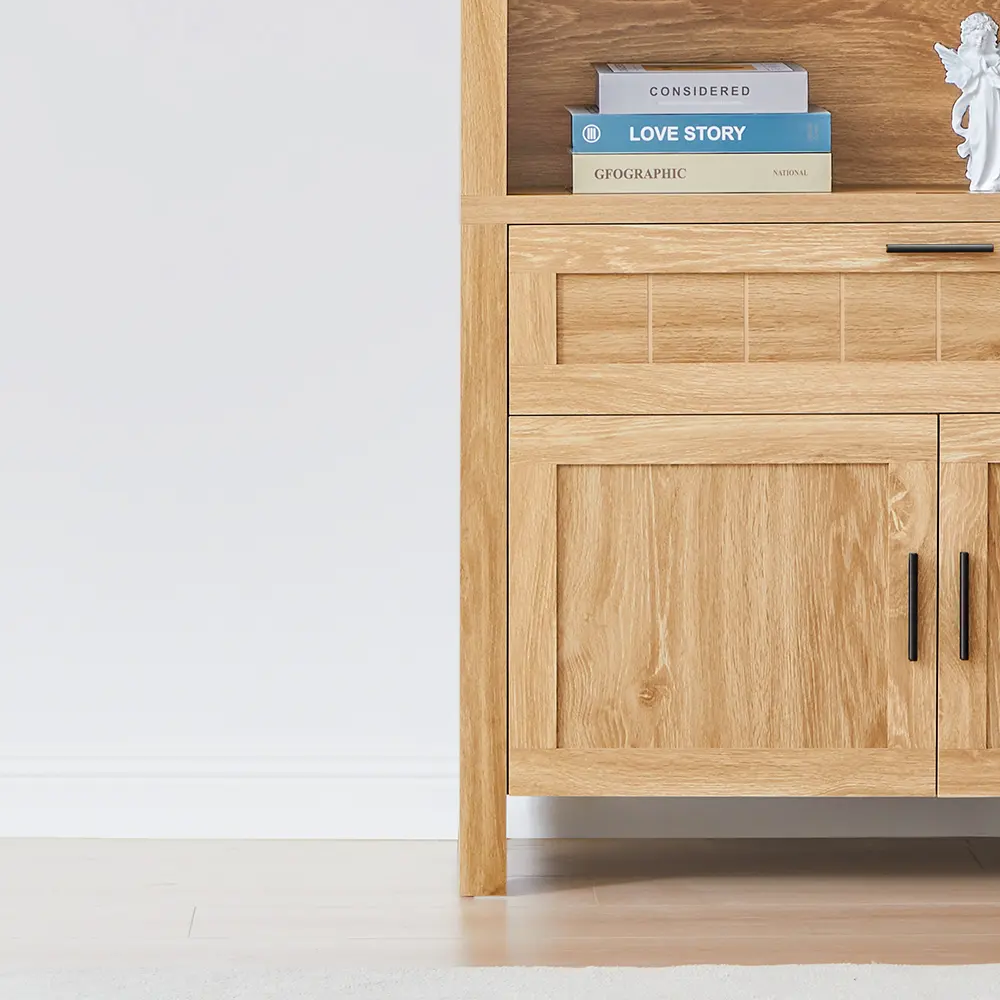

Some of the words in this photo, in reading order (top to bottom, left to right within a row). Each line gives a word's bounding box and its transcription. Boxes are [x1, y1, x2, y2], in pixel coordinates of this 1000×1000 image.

[650, 86, 750, 97] CONSIDERED
[629, 126, 679, 142] LOVE
[684, 126, 747, 141] STORY
[594, 167, 687, 180] GFOGRAPHIC
[773, 169, 809, 177] NATIONAL
